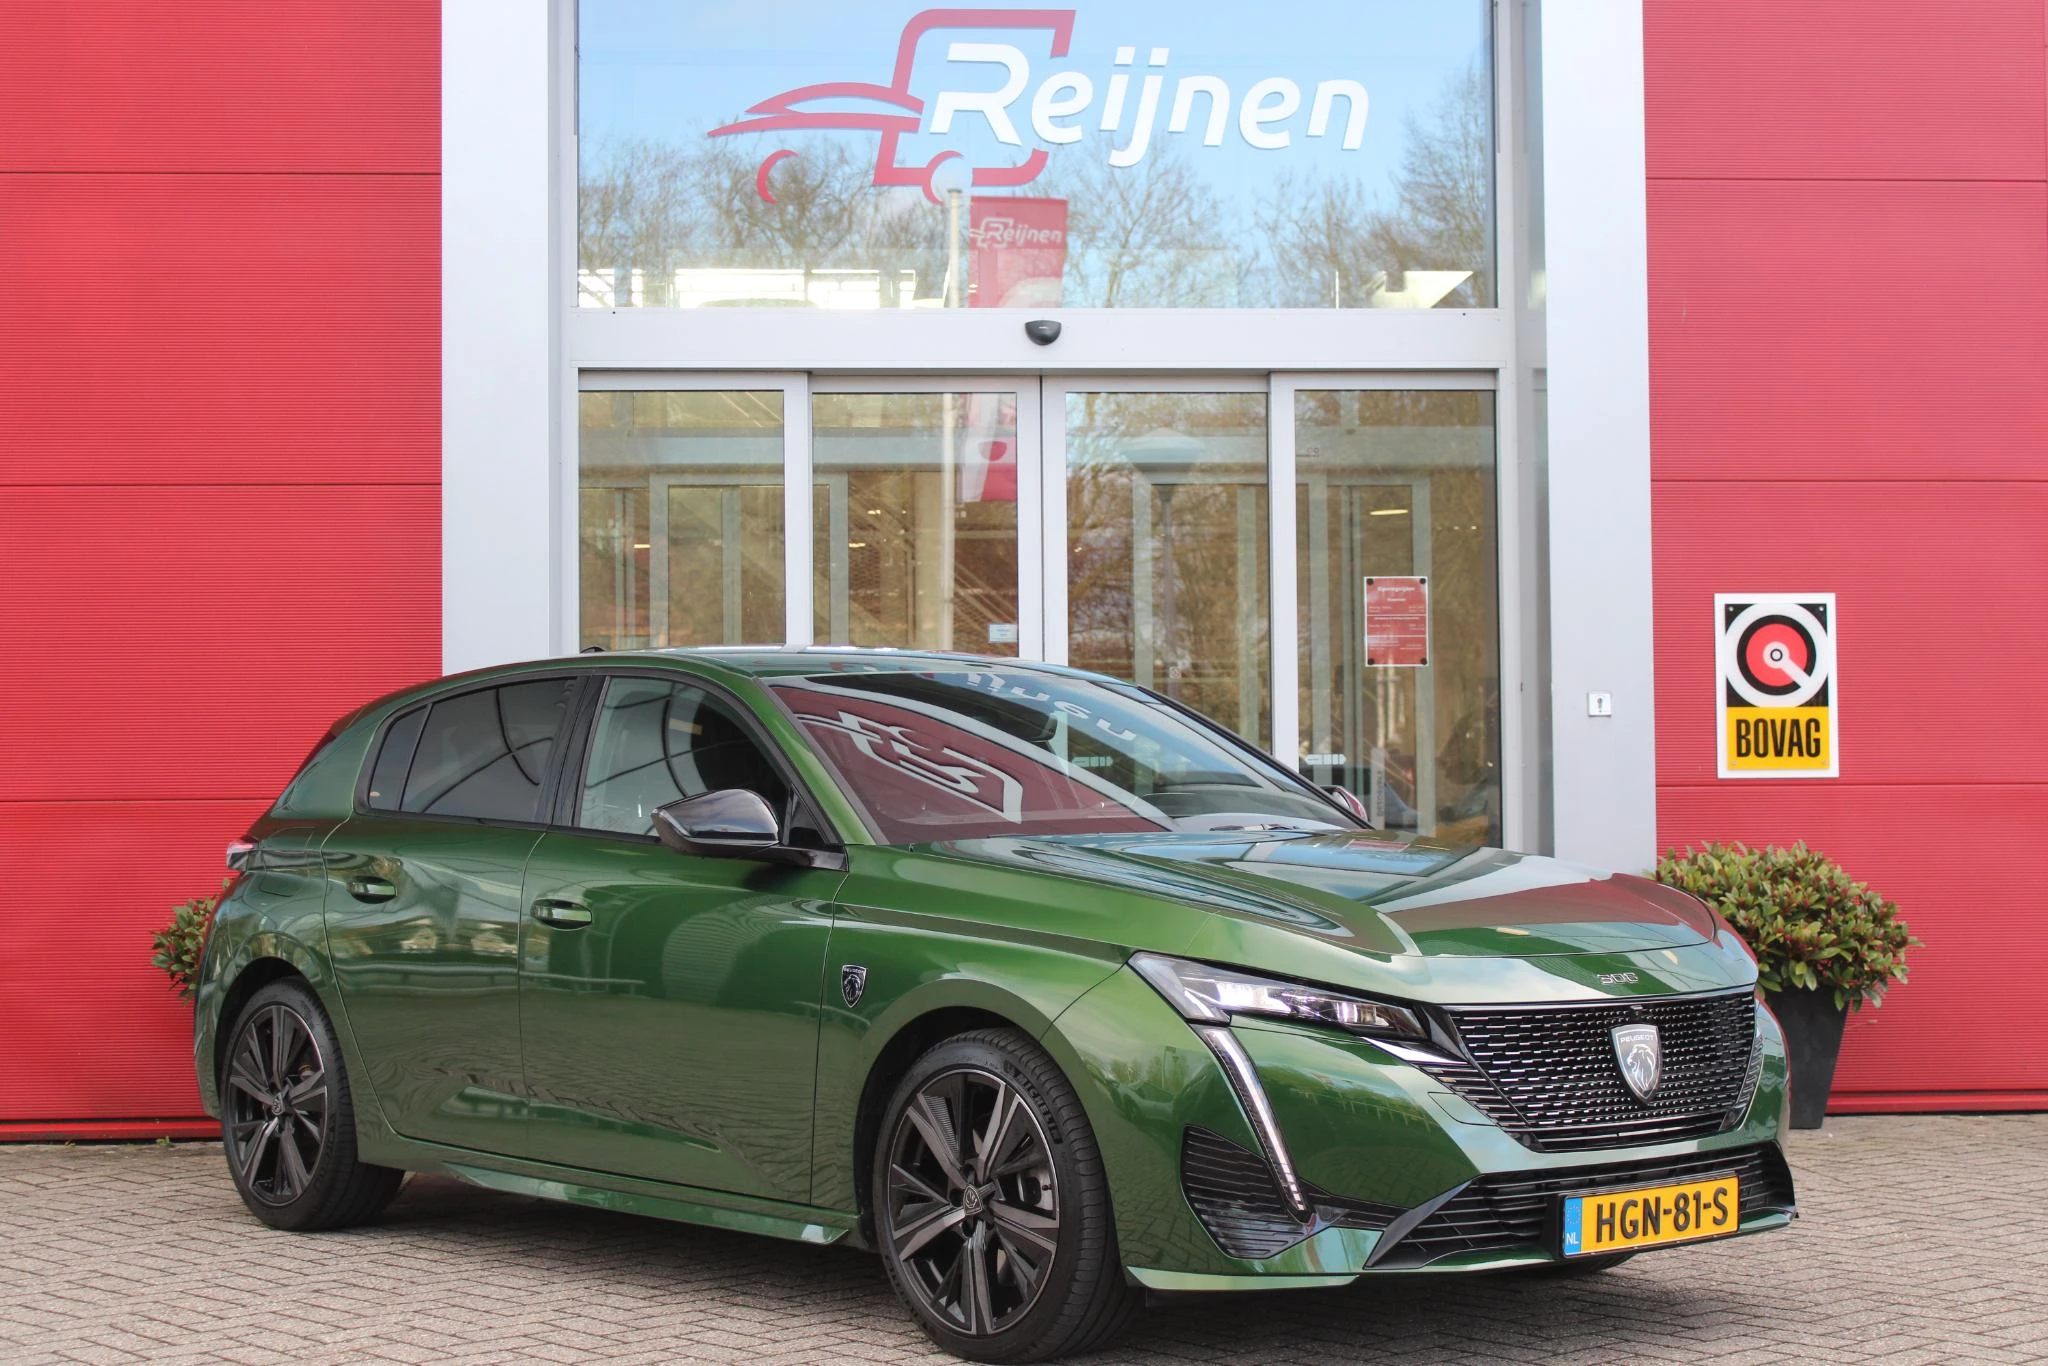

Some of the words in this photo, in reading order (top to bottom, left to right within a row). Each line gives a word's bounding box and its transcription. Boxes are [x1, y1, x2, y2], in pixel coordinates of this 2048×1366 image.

[928, 43, 1370, 168] Reijnen
[986, 223, 1062, 246] Reijnen
[1736, 718, 1821, 758] BOVAG
[1620, 1034, 1654, 1043] PEUGEOT
[1596, 1187, 1728, 1242] HGN-81-S
[1566, 1232, 1579, 1245] NL
